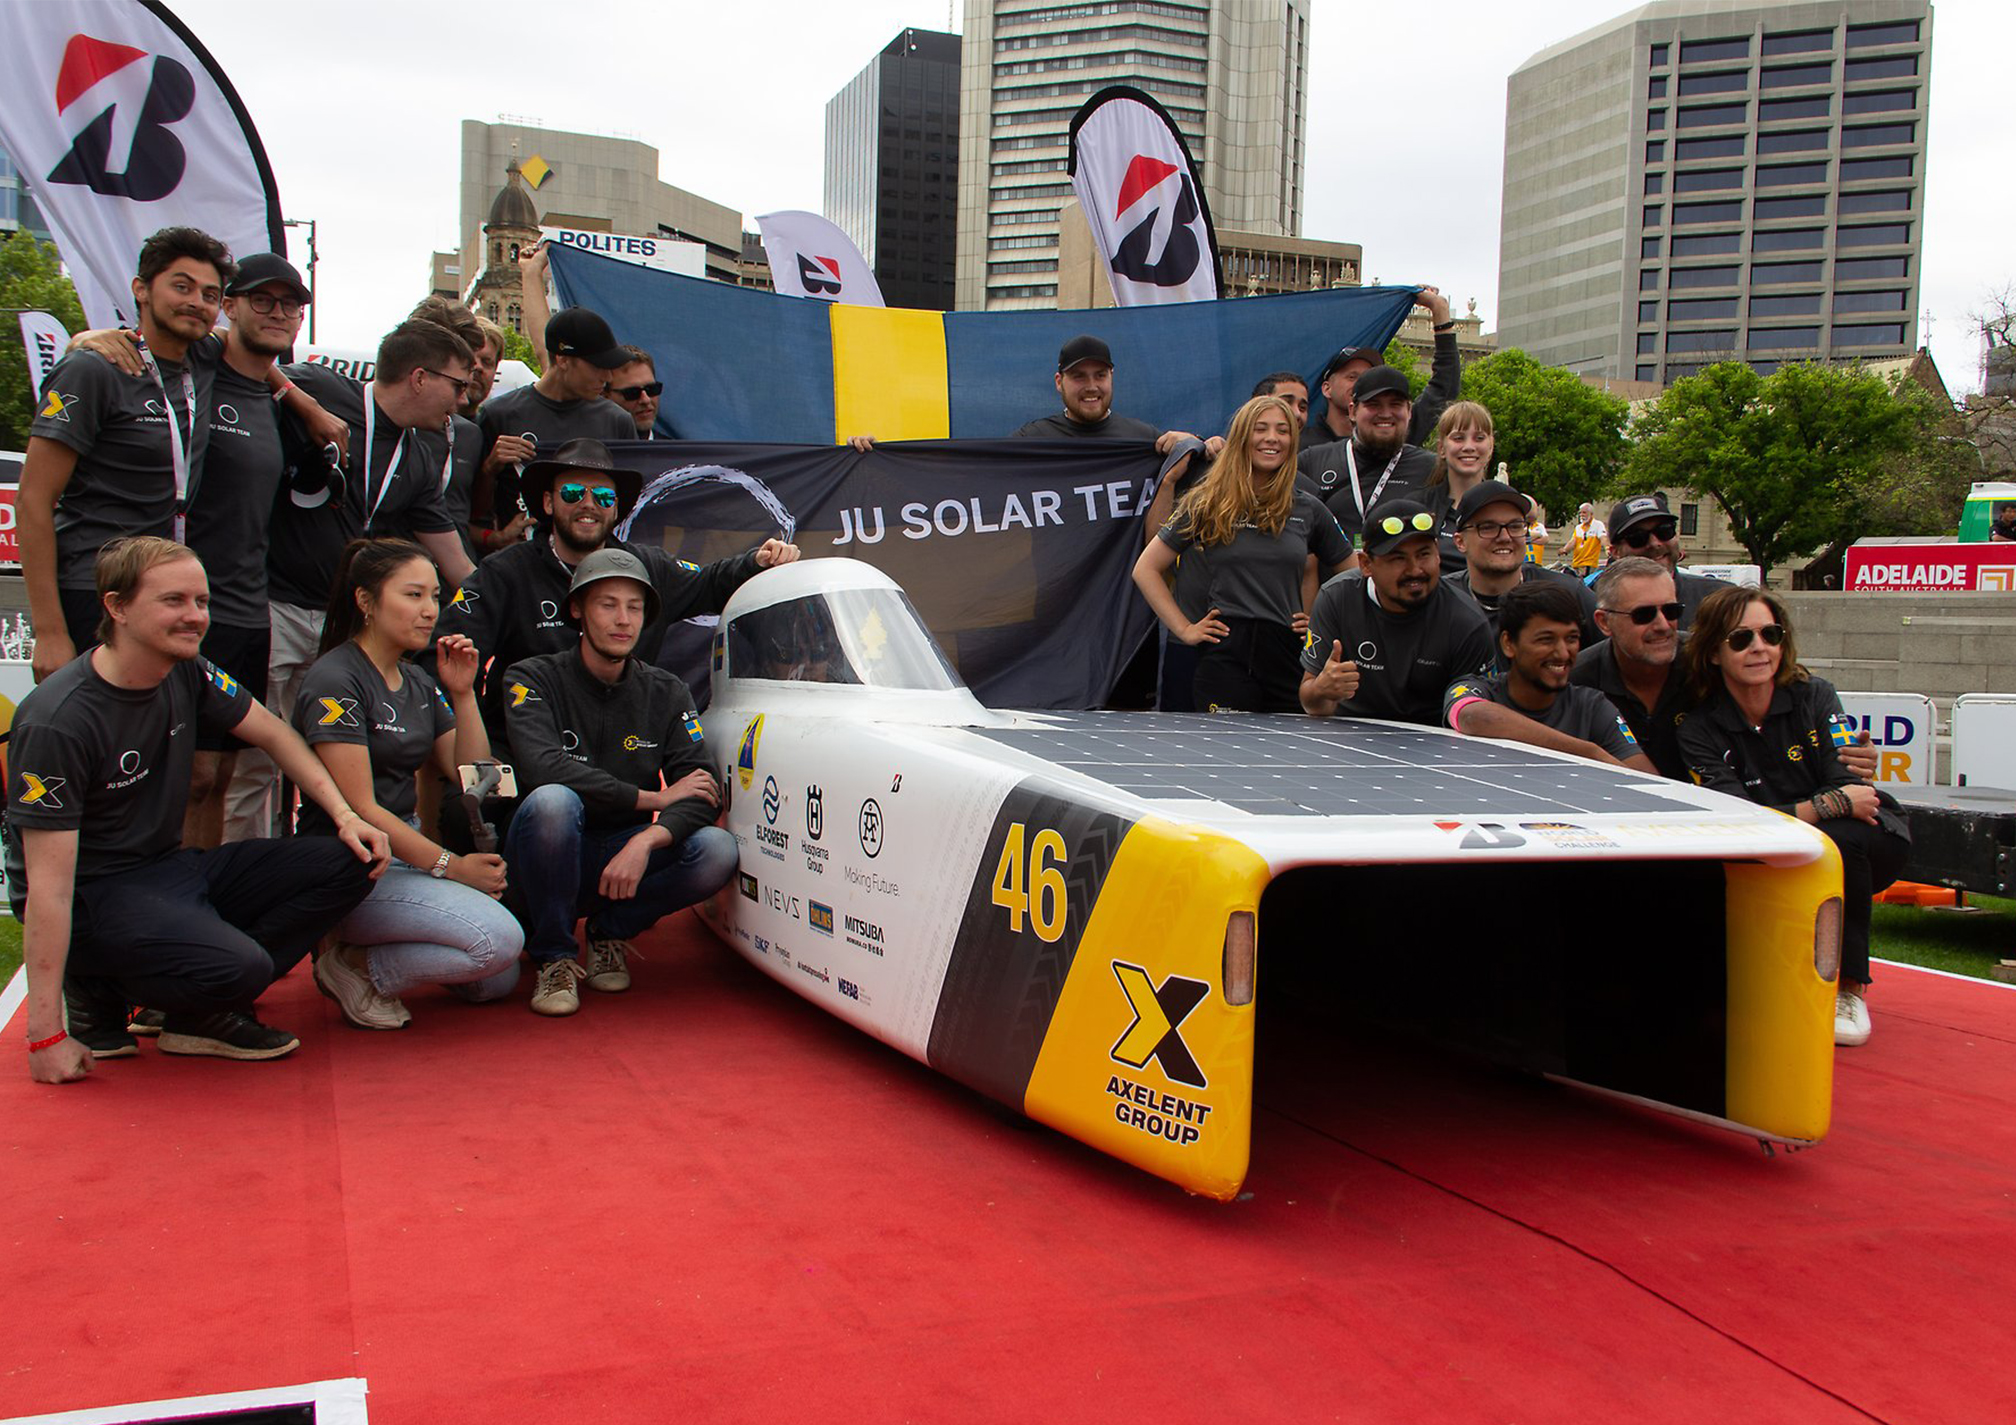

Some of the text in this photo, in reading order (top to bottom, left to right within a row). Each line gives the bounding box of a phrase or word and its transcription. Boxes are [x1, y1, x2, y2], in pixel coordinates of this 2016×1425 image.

[558, 231, 657, 256] POLITES
[832, 506, 887, 546] JU
[900, 490, 1064, 540] SOLAR
[1854, 564, 1967, 585] ADELAIDE
[756, 824, 789, 849] ELFOREST
[1554, 841, 1621, 849] CHALLENGE
[807, 857, 824, 875] Group
[992, 822, 1068, 943] 46
[765, 885, 800, 919] NEVS
[845, 915, 885, 944] MITSUBA
[837, 977, 859, 1000] NEFAB
[1106, 1076, 1211, 1126] AXELENT
[1115, 1103, 1199, 1146] GROUP
